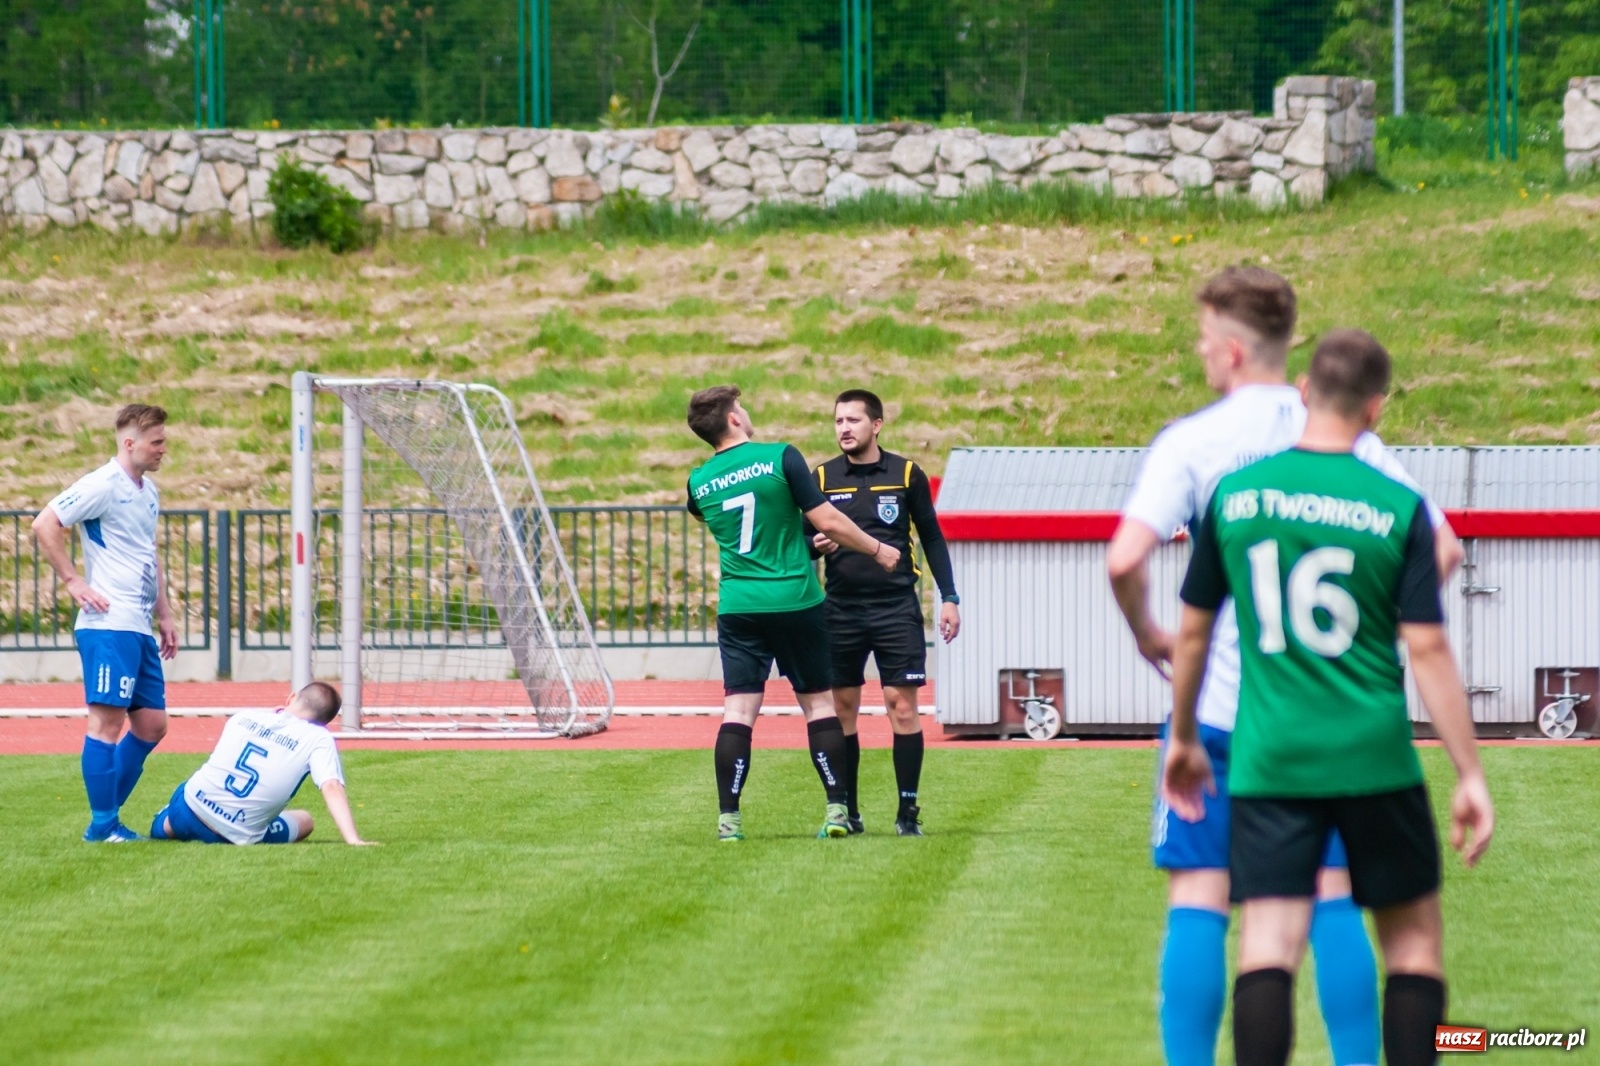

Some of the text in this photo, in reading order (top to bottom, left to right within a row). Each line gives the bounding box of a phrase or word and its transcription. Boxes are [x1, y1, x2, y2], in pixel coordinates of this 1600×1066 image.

[710, 461, 774, 492] TWORKÓW
[722, 491, 756, 554] 7
[1247, 538, 1360, 658] 16
[119, 676, 136, 699] 90
[224, 741, 269, 799] 5
